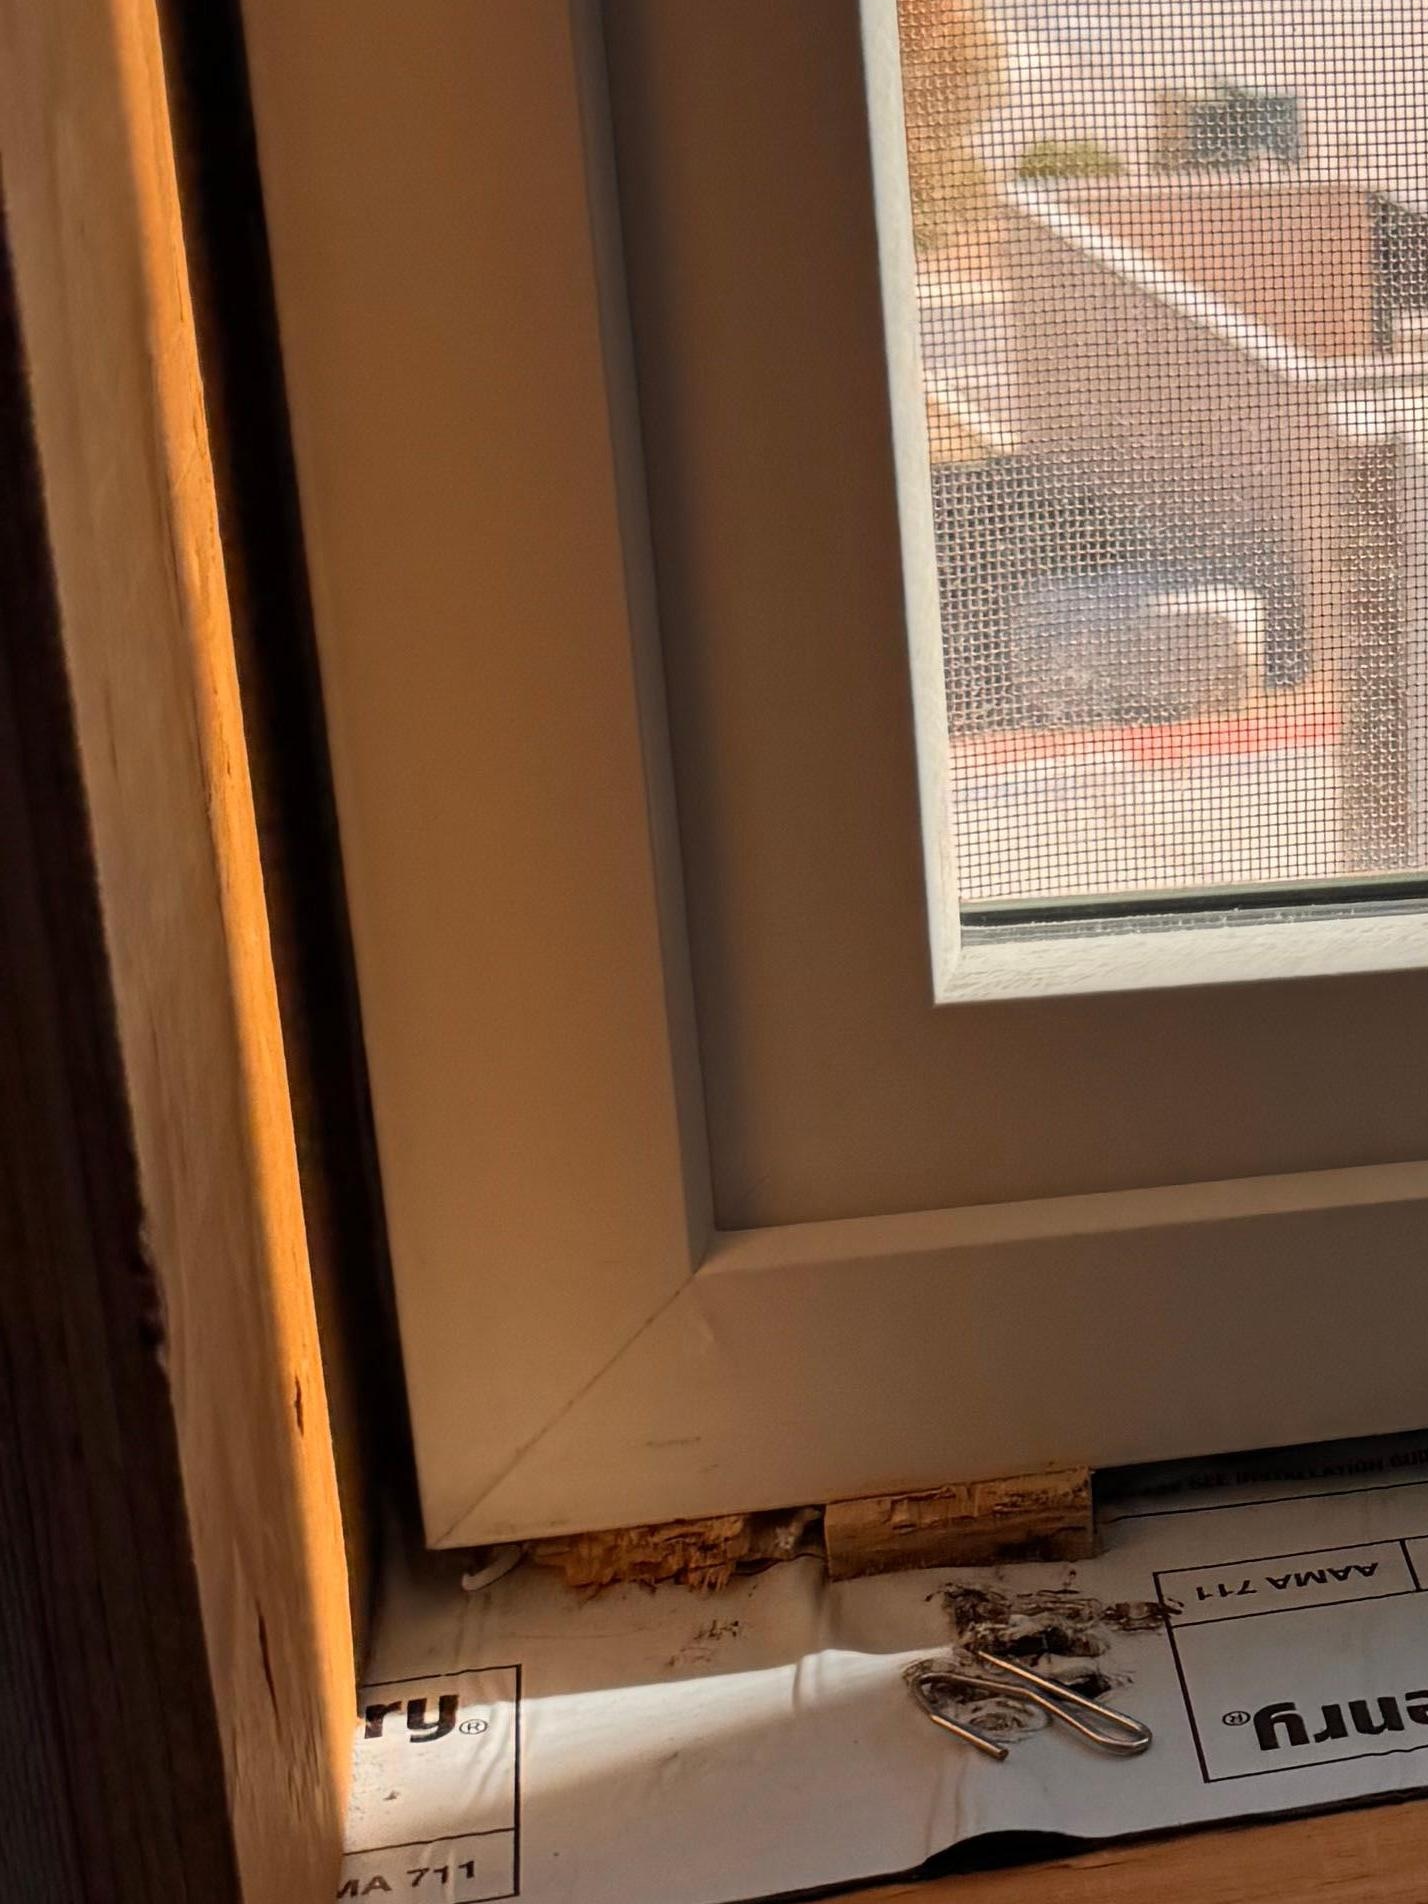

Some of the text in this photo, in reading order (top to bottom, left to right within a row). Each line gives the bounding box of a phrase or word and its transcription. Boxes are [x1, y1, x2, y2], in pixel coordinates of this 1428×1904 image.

[1193, 1560, 1378, 1602] AAMA 711
[407, 1860, 475, 1888] 711
